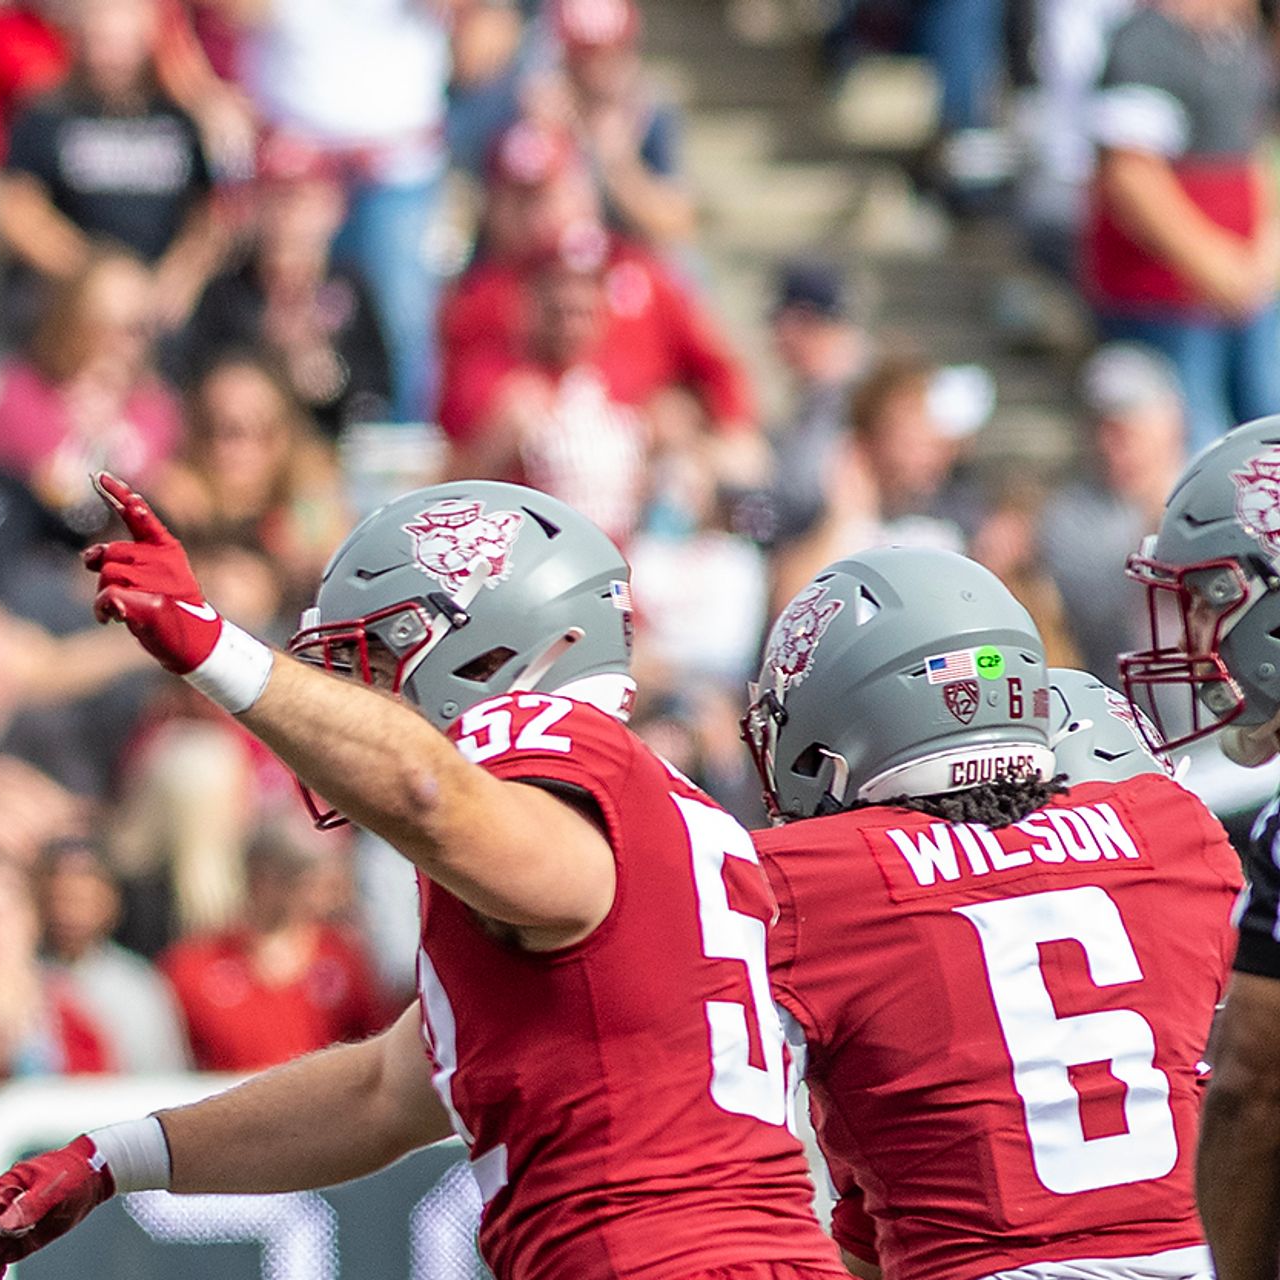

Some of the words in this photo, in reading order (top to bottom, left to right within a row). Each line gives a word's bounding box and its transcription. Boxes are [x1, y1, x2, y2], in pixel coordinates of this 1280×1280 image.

[455, 694, 573, 764] 52
[1006, 677, 1024, 720] 6
[886, 803, 1140, 886] WILSON
[668, 790, 795, 1138] 5
[951, 885, 1180, 1195] 6
